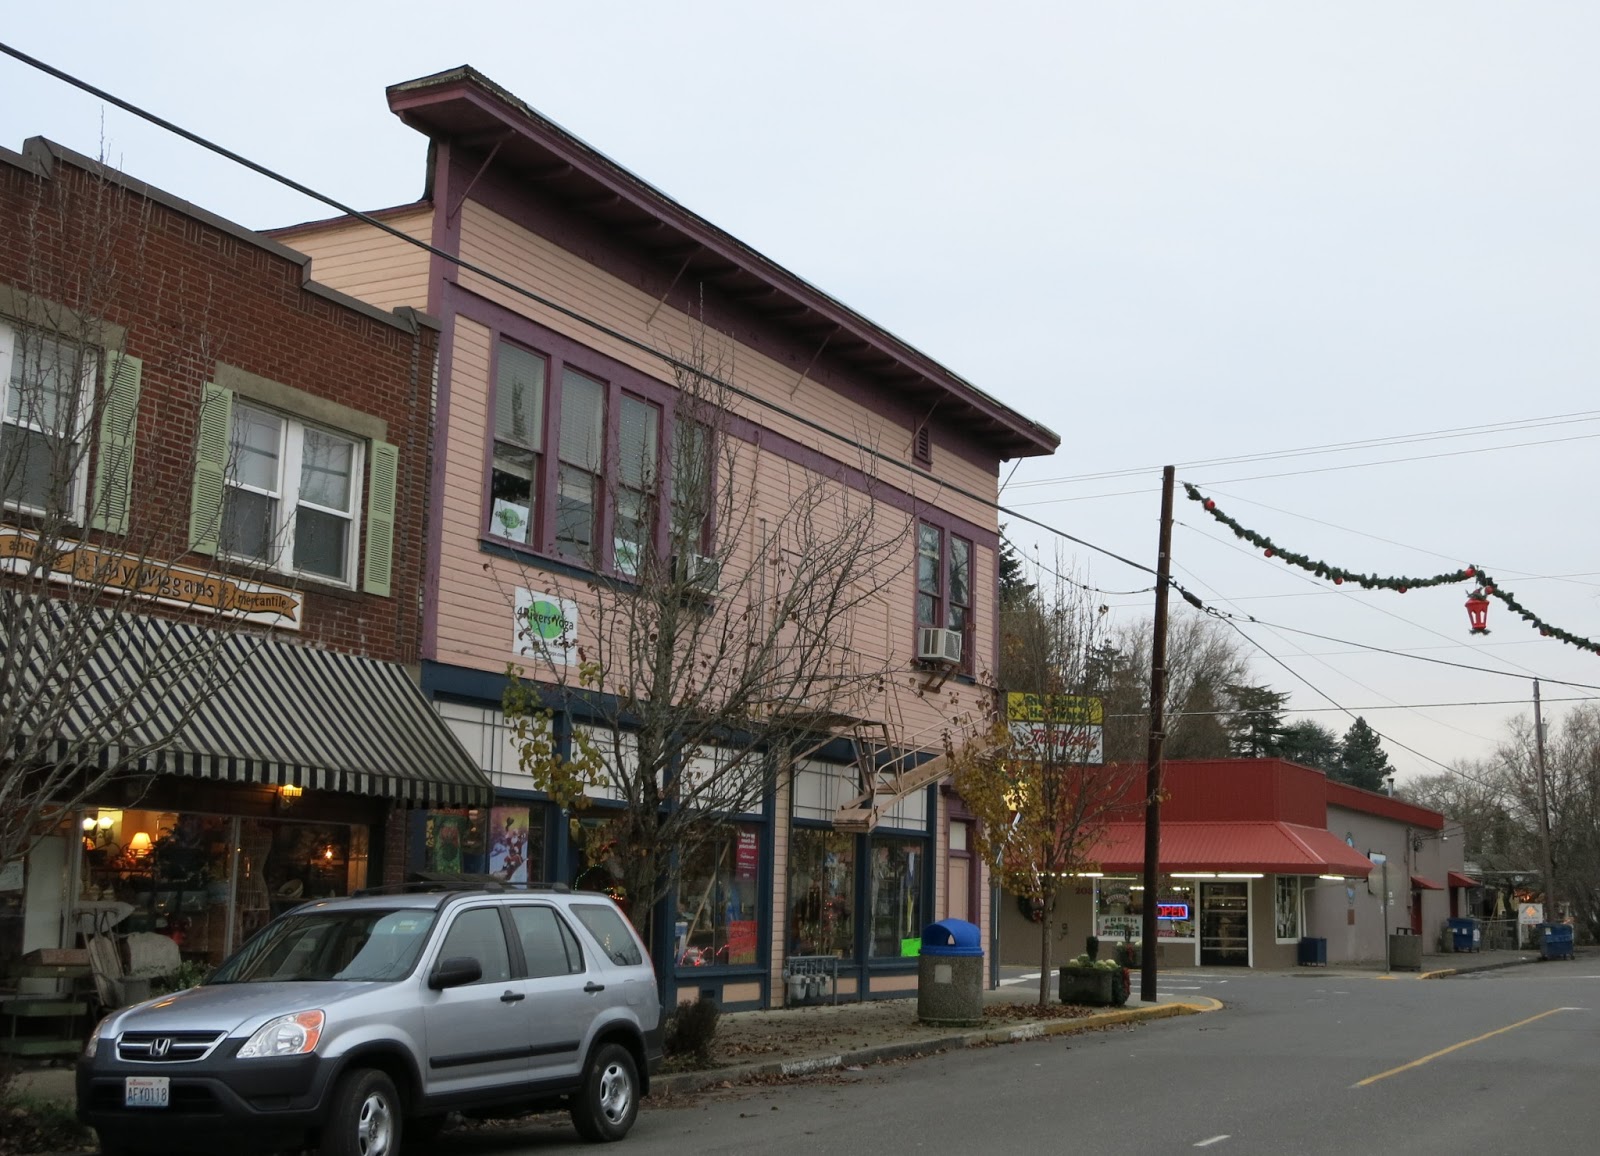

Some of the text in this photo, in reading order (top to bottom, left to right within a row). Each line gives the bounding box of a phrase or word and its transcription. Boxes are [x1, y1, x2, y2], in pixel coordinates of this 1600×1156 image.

[237, 594, 287, 608] mercantile
[1104, 916, 1137, 924] FRESH
[128, 1087, 167, 1102] AFY0118
